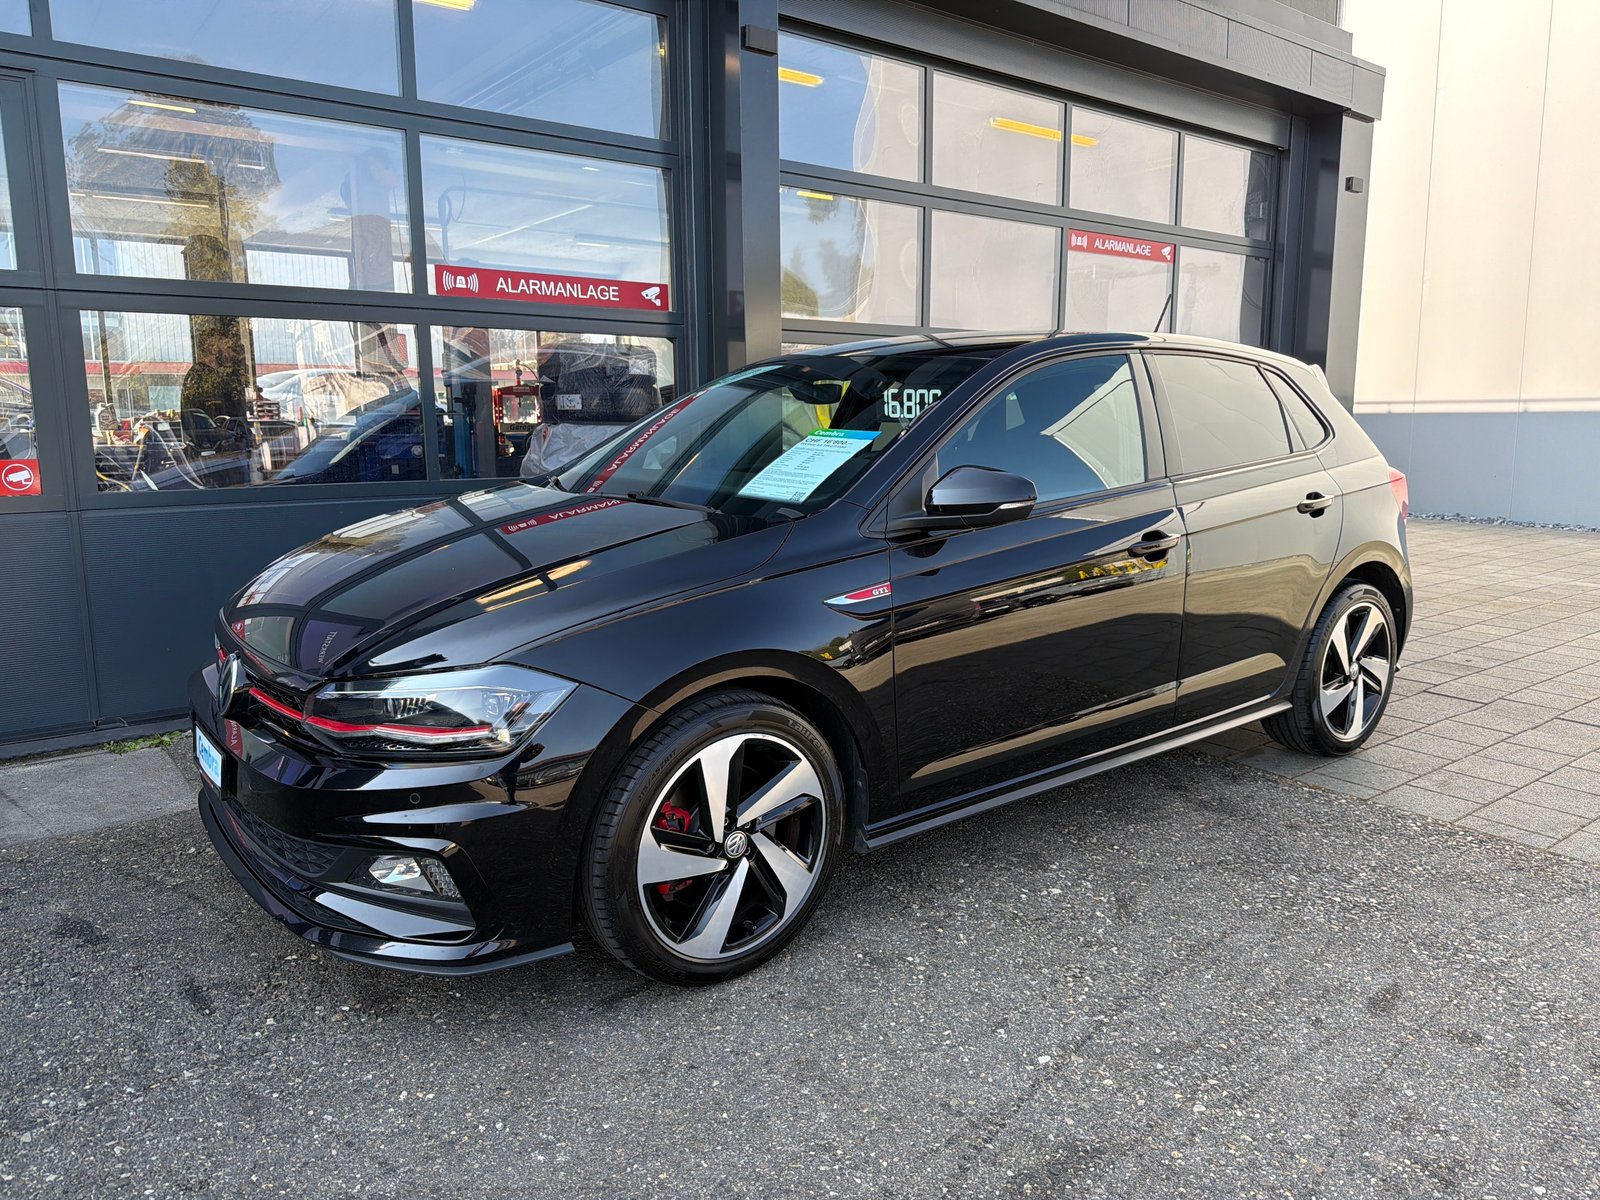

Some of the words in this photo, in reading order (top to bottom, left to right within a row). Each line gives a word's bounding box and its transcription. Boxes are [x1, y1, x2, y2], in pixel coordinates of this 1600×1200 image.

[1094, 238, 1151, 256] ALARMANLAGE
[496, 277, 620, 301] ALARMANLAGE
[872, 587, 889, 596] GTI
